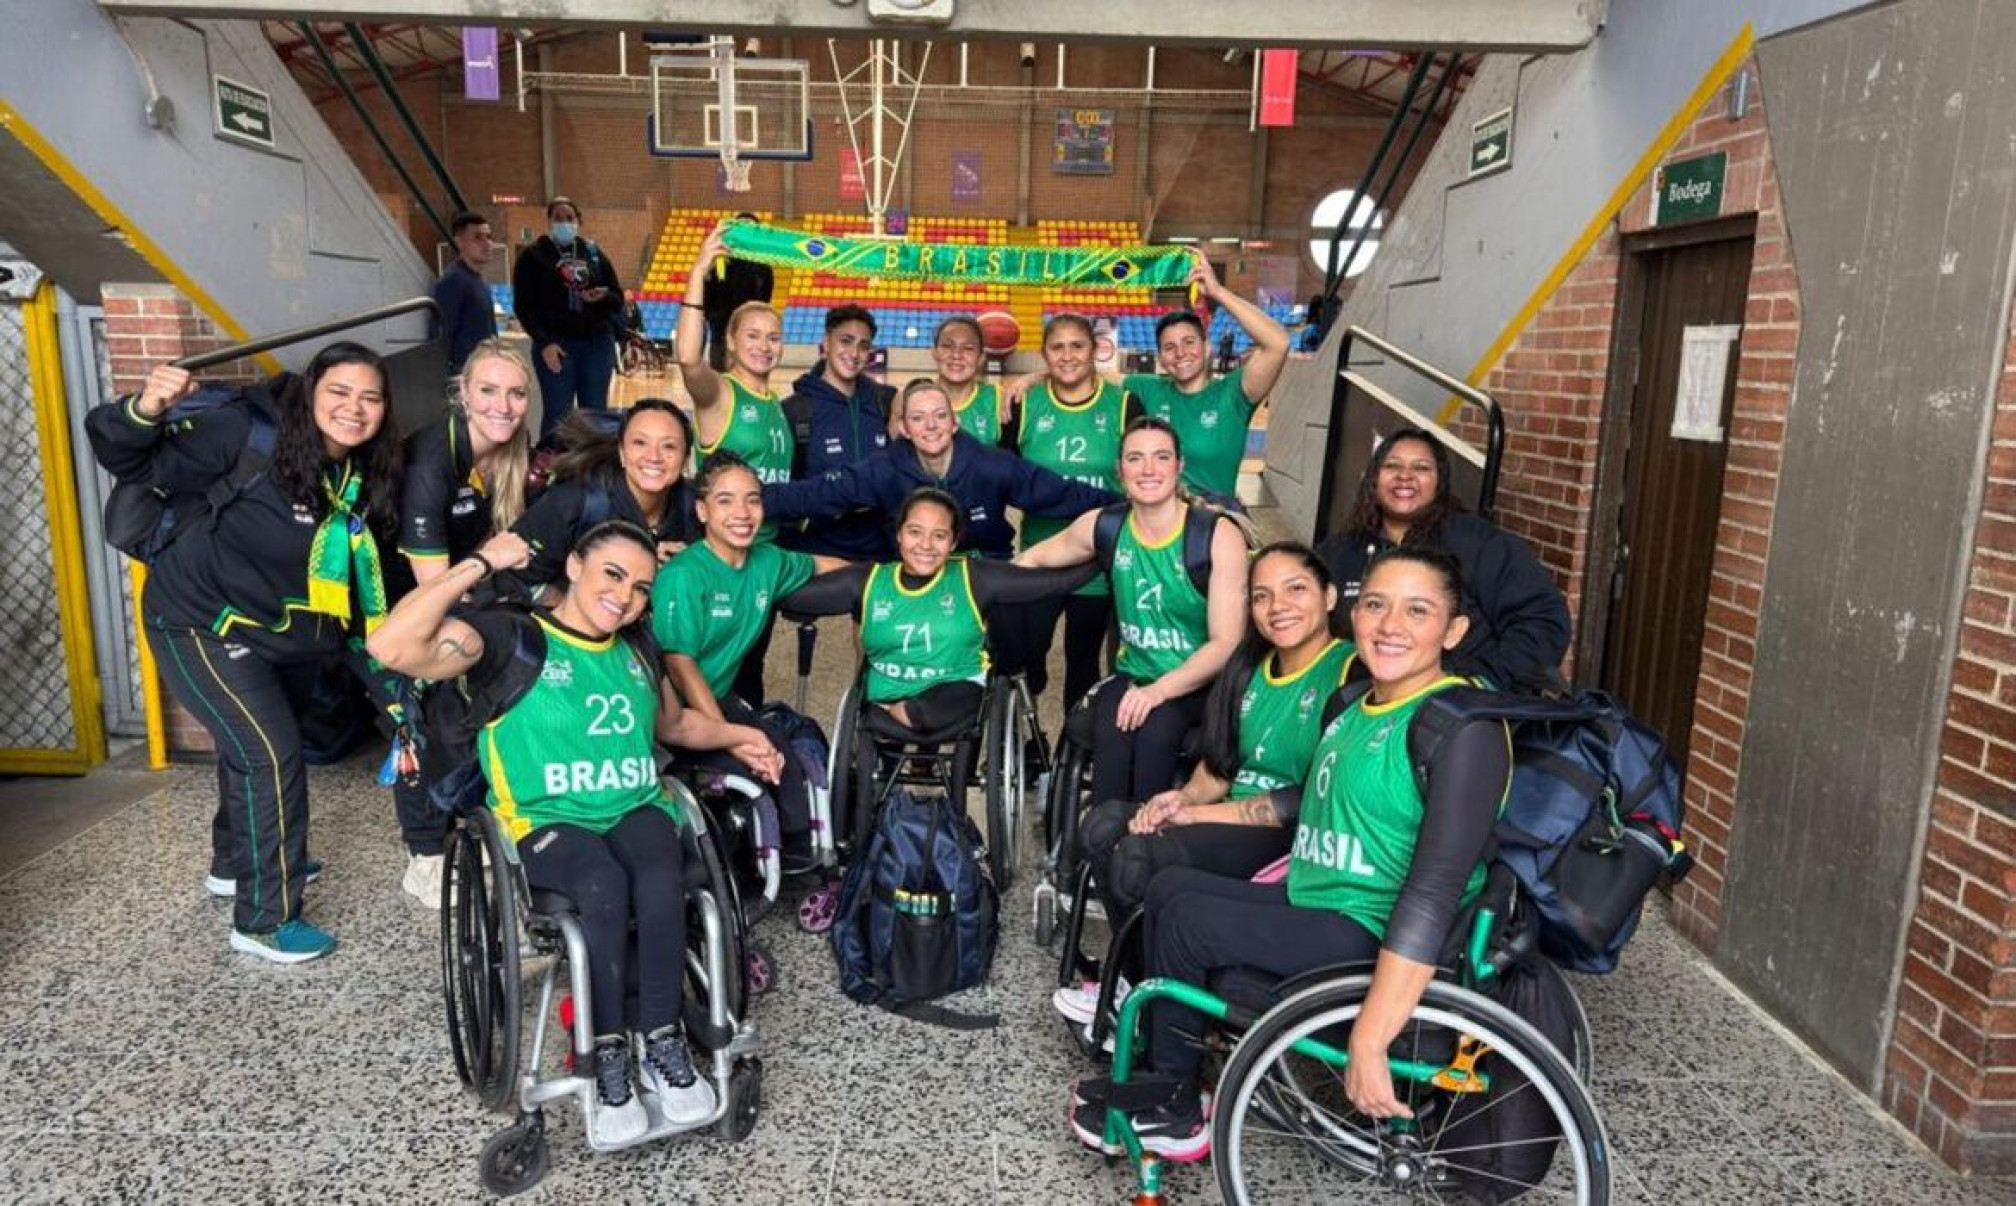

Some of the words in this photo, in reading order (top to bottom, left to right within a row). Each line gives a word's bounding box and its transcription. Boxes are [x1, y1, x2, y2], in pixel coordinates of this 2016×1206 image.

[1668, 178, 1711, 203] Bodega
[884, 245, 1056, 278] BRASIL
[769, 428, 785, 454] 11
[1055, 435, 1088, 463] 12
[895, 622, 932, 653] 71
[585, 693, 635, 735] 23
[1316, 751, 1337, 799] 6
[1293, 824, 1375, 876] RASIL
